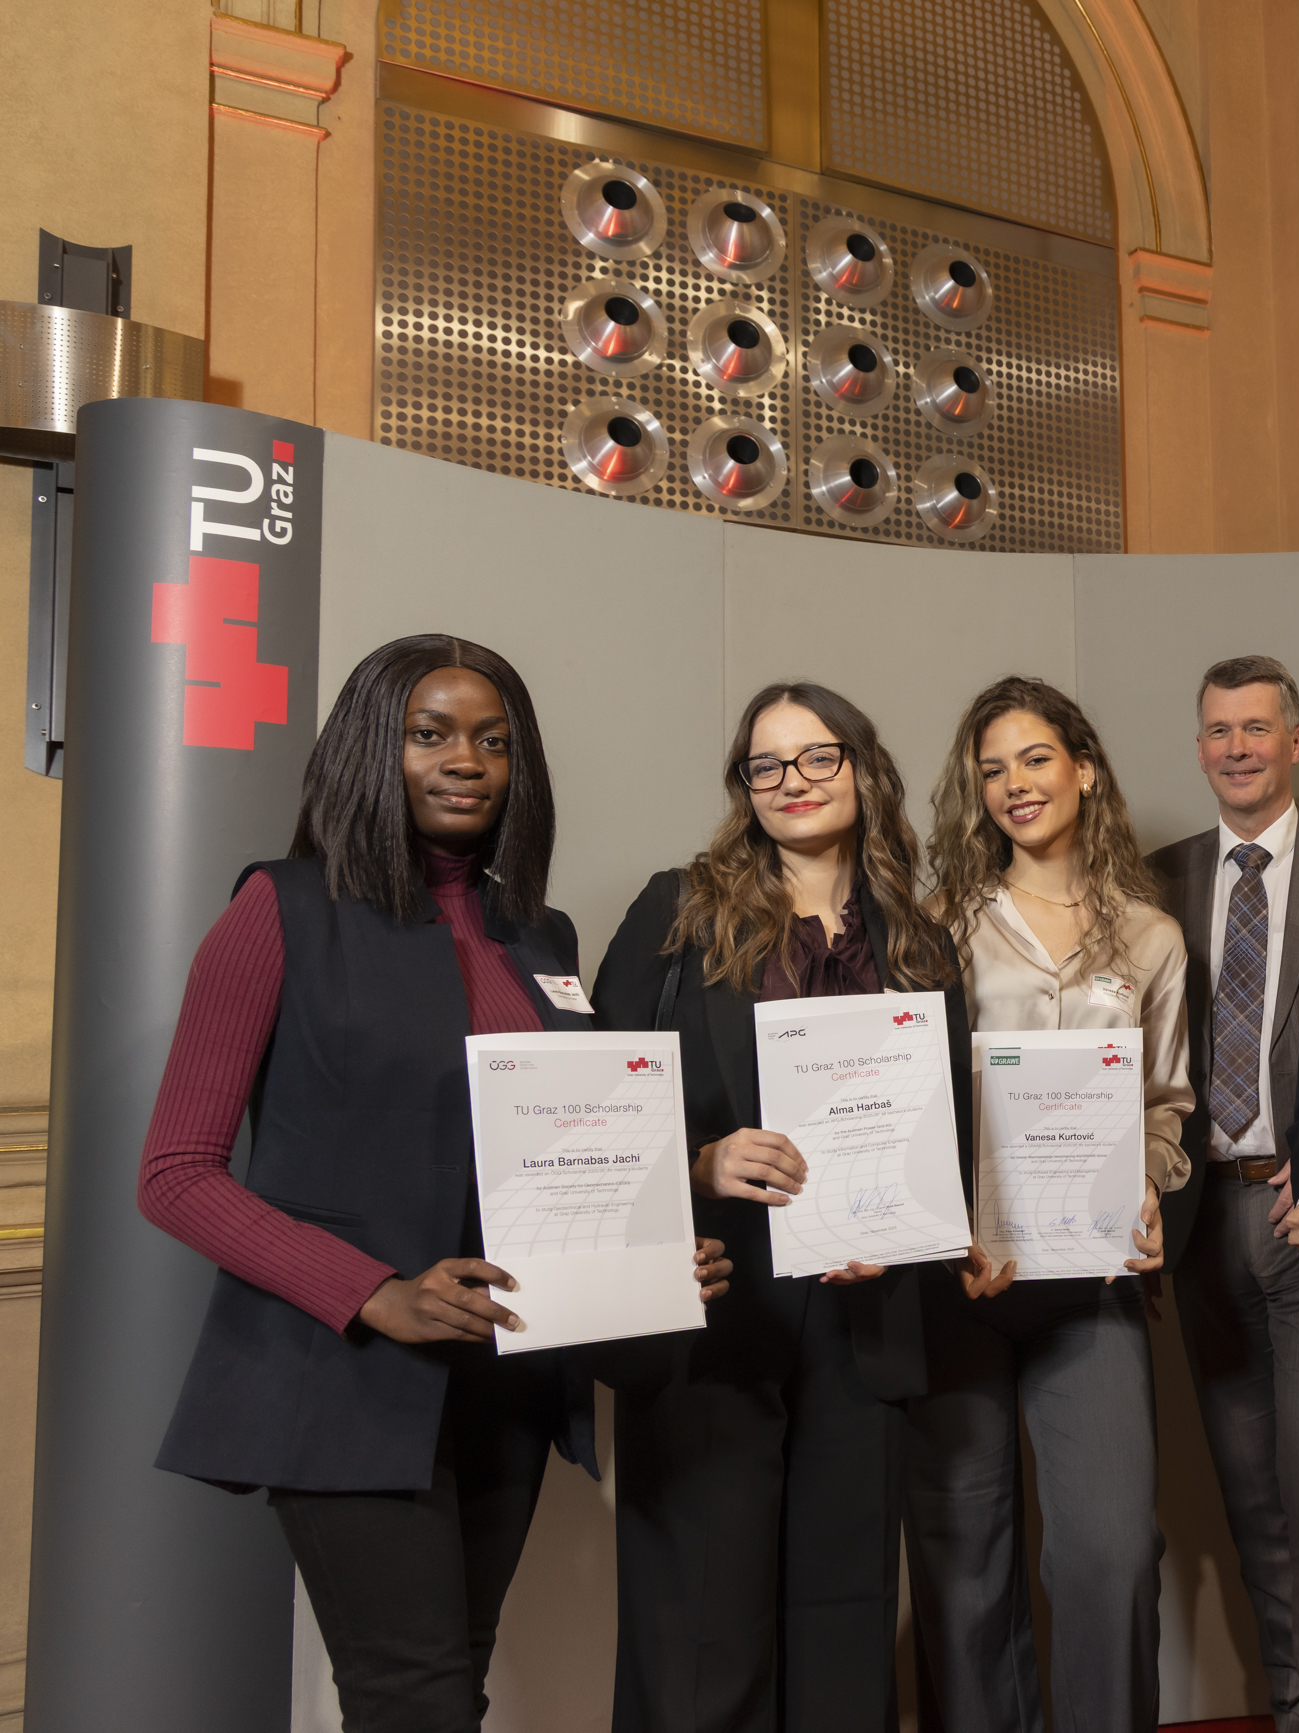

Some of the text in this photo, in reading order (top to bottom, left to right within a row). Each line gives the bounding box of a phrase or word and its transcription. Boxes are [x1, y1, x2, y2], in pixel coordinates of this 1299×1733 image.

[189, 447, 265, 551] TU
[262, 462, 294, 546] Graz
[650, 1060, 662, 1068] TU
[794, 1052, 912, 1074] TU Graz 100 Scholarship
[831, 1067, 880, 1081] Certificate
[1064, 1091, 1113, 1101] Scholarship
[514, 1103, 643, 1116] TU Graz 100 Scholarship
[829, 1099, 892, 1116] Alma Harbaš
[1039, 1102, 1082, 1111] Certificate
[554, 1117, 607, 1128] Certificate
[1059, 1132, 1094, 1141] Kurtović
[523, 1153, 640, 1168] Laura Barnabas Jachi
